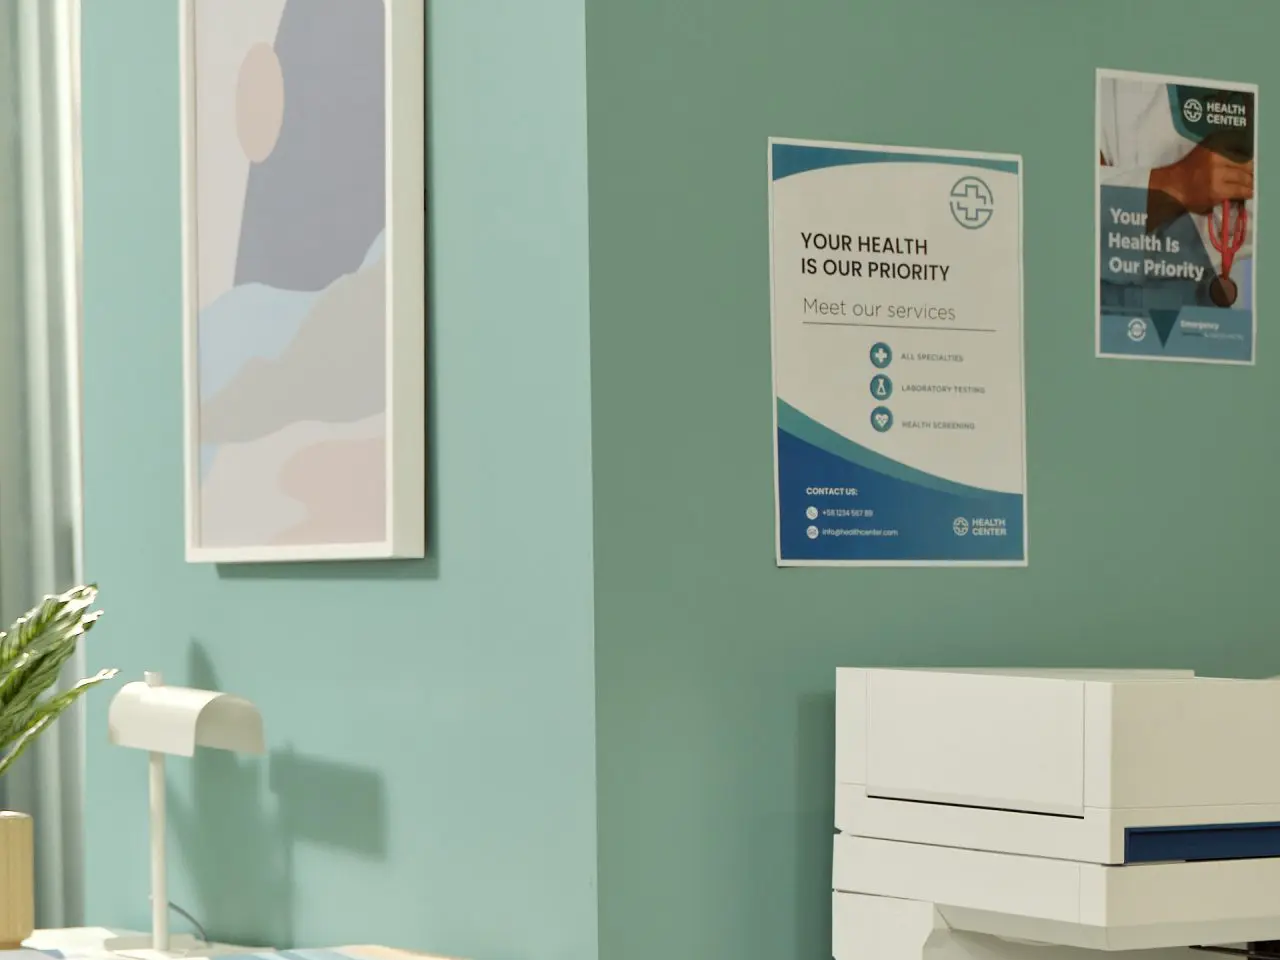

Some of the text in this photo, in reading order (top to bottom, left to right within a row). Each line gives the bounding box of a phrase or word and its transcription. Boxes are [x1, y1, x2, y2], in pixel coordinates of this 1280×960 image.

[1206, 101, 1246, 116] HEALTH
[1206, 114, 1247, 127] CENTER
[1109, 207, 1149, 226] Your
[801, 232, 928, 255] YOUR HEALTH
[1108, 231, 1181, 254] Health Is
[801, 257, 951, 282] IS OUR PRIORITY
[1108, 256, 1205, 282] Our Priority
[803, 297, 956, 321] Meet our services
[900, 352, 915, 361] ALL
[901, 384, 986, 395] LABORATORY TESTING
[901, 420, 976, 431] HEALTH SCREENING
[805, 486, 859, 497] CONTACT US:
[971, 517, 1006, 528] HEALTH
[971, 526, 1008, 537] CENTER
